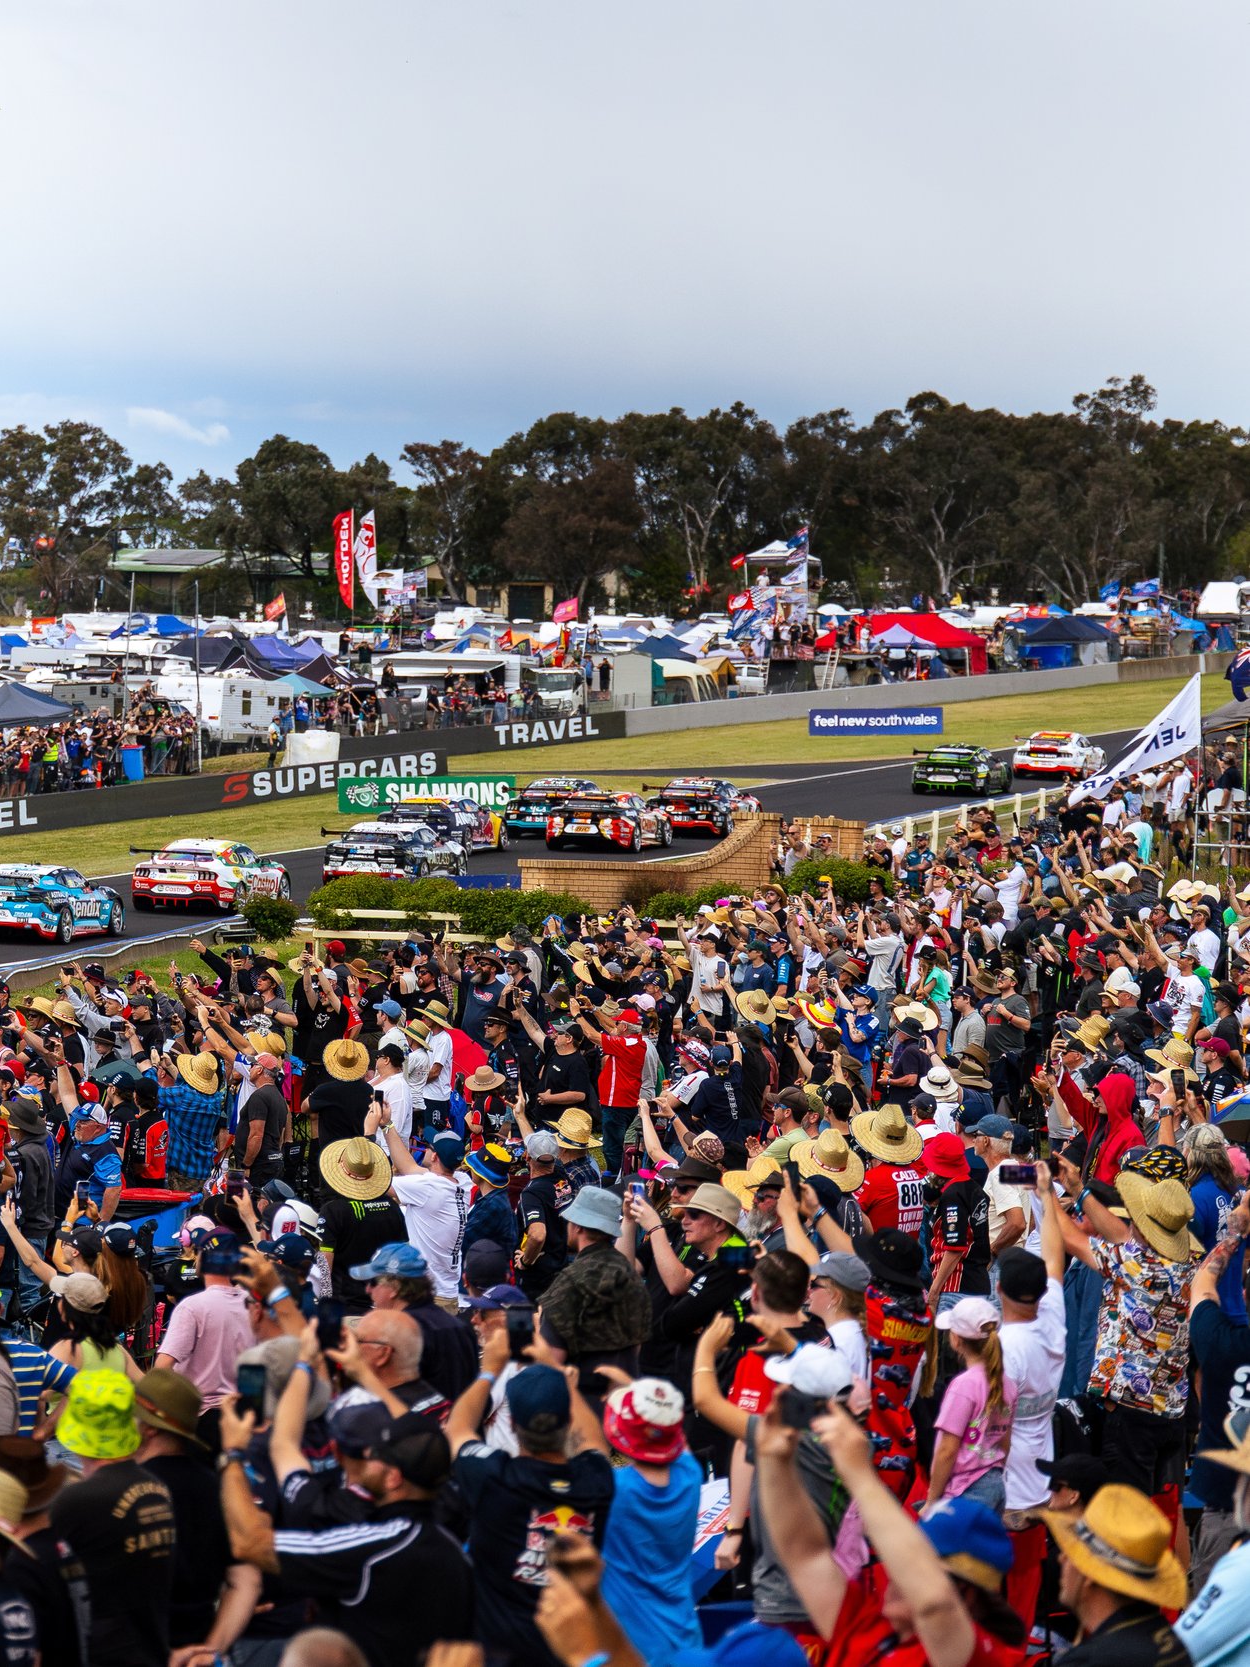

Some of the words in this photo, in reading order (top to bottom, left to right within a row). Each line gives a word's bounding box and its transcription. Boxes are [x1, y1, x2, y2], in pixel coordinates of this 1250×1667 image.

[494, 716, 599, 746] TRAVEL
[814, 714, 838, 727] feel
[839, 717, 867, 727] new
[868, 714, 901, 727] south
[903, 713, 938, 726] wales
[253, 752, 437, 797] SUPERCARS
[385, 781, 509, 806] SHANNONS
[164, 884, 188, 893] Castrol
[70, 896, 101, 918] Bendix
[891, 1169, 919, 1182] CALTE
[1181, 1583, 1223, 1631] CLUB
